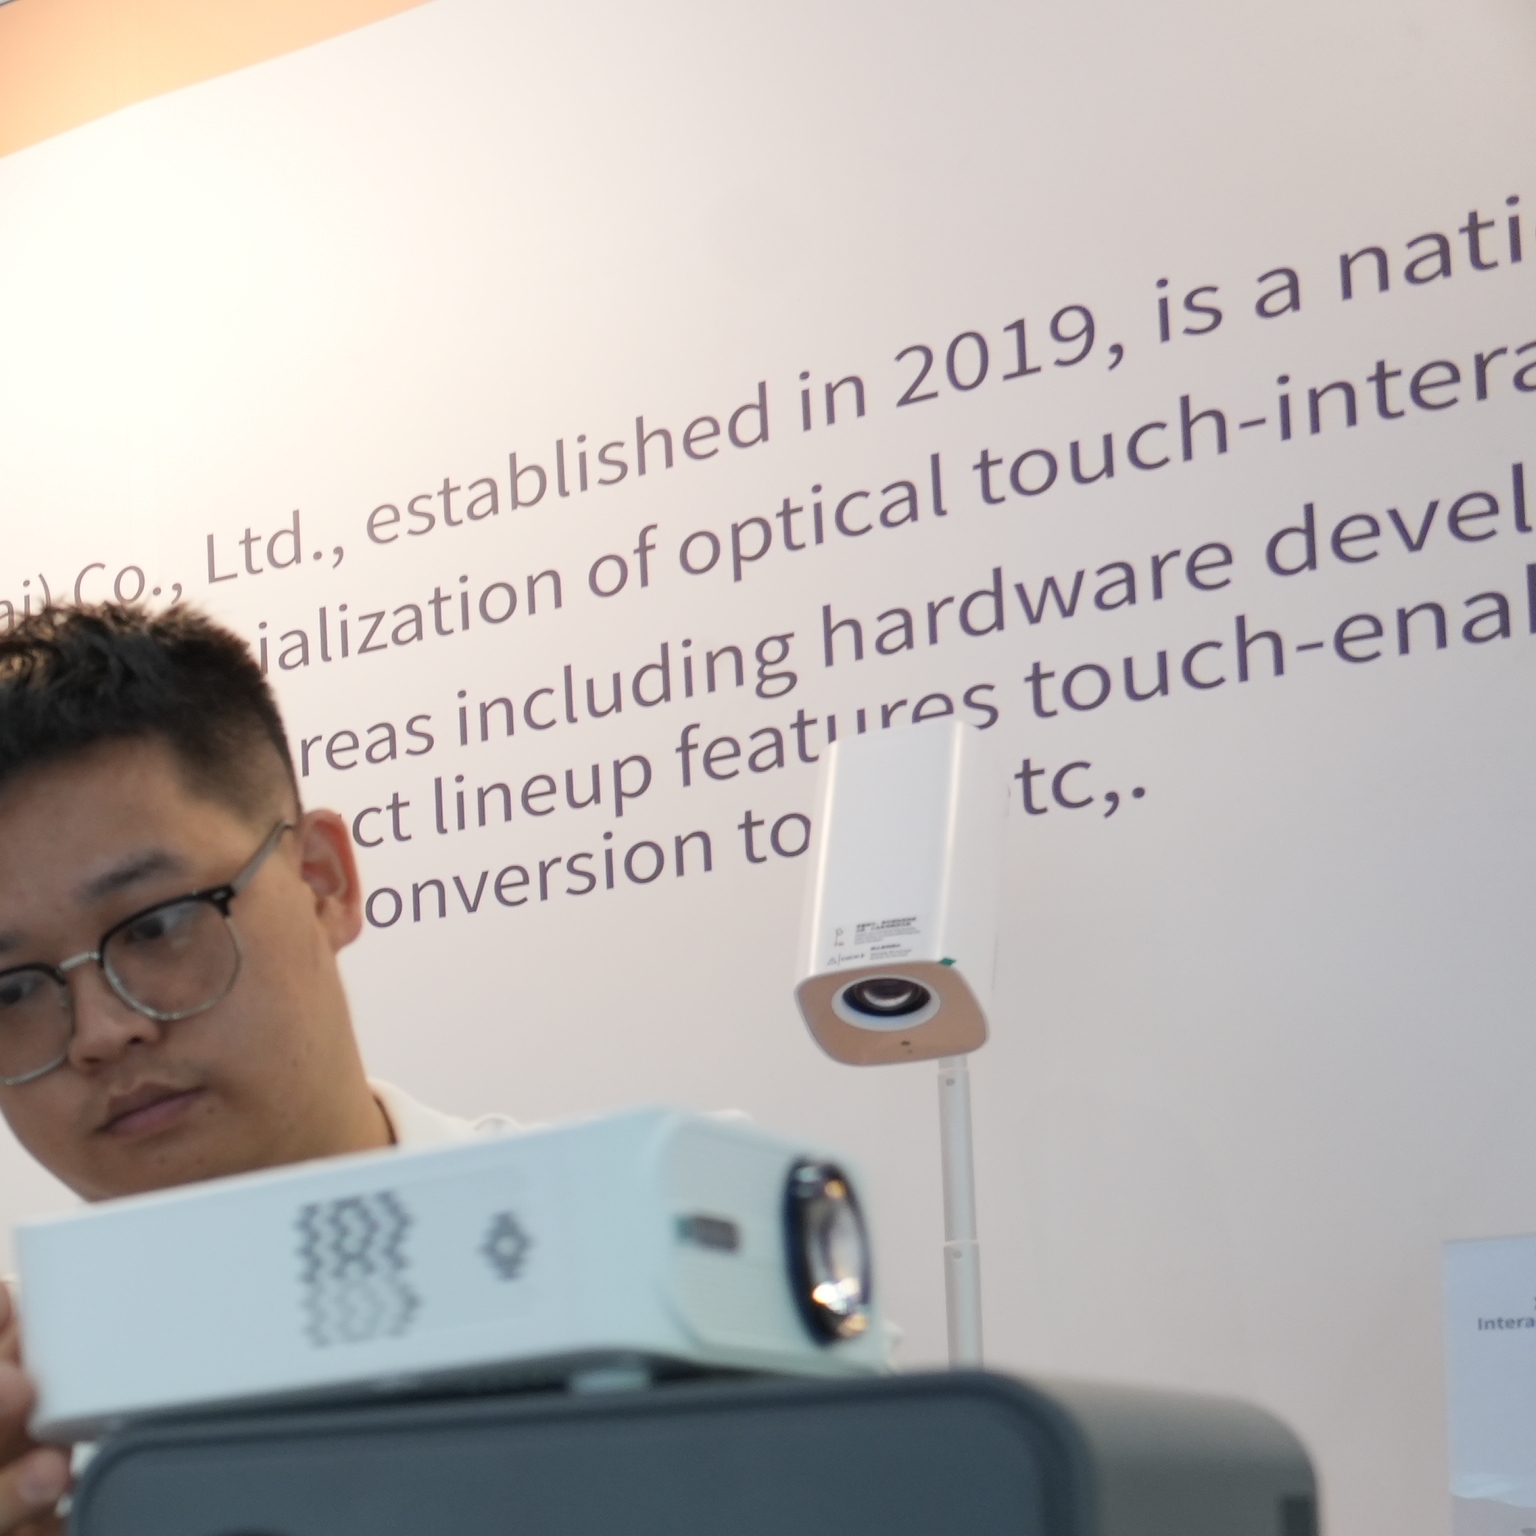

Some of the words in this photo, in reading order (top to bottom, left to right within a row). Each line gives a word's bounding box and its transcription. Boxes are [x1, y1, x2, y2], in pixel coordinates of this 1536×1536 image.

[205, 508, 345, 584] Ltd.,
[365, 381, 770, 546] established
[799, 370, 867, 431] in
[894, 303, 1124, 408] 2019,
[1155, 278, 1224, 342] is
[1254, 266, 1302, 319] a
[587, 523, 658, 597] of
[678, 453, 947, 582] optical
[457, 628, 798, 744] including
[822, 539, 1233, 667] hardware
[434, 753, 652, 834] lineup
[737, 808, 812, 865] to
